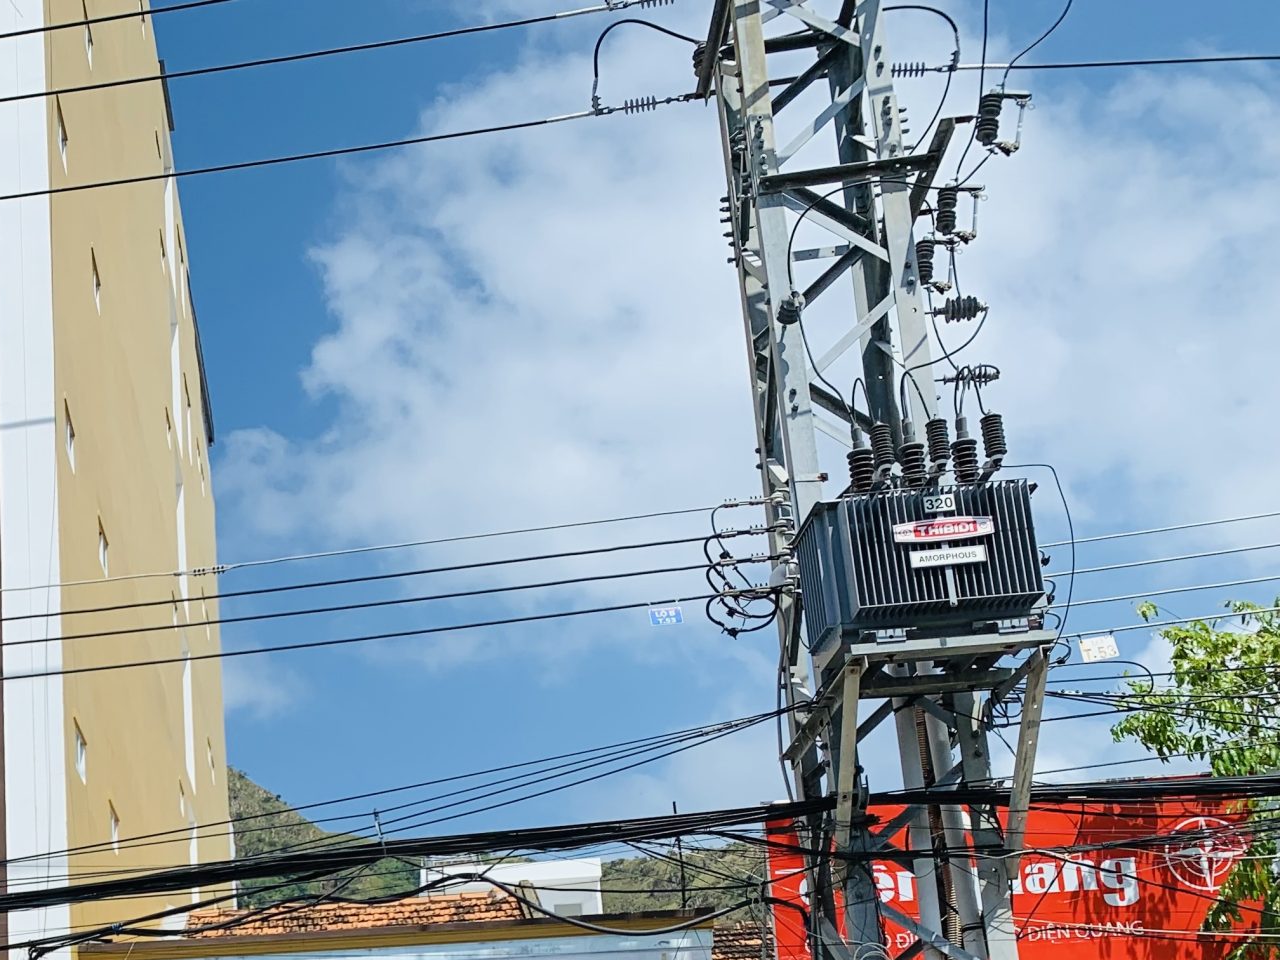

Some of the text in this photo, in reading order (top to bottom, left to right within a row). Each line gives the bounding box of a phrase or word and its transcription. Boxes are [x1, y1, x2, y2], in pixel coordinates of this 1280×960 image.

[925, 497, 953, 510] 320
[919, 551, 977, 562] AMORPHOUS
[1083, 645, 1117, 661] T.53
[1075, 921, 1145, 939] QUANG
